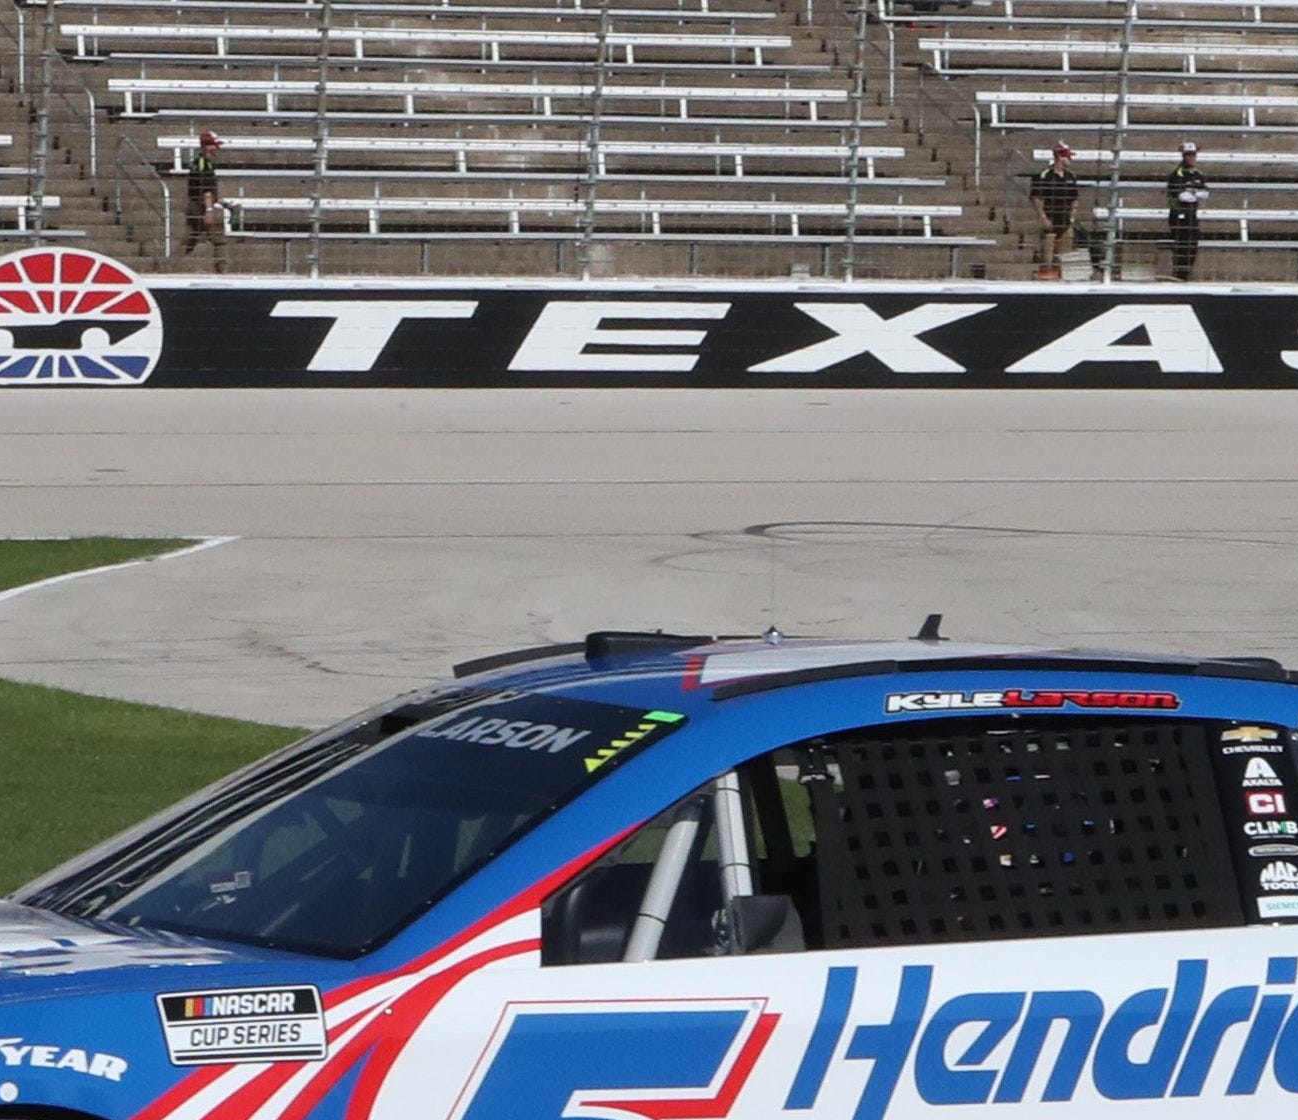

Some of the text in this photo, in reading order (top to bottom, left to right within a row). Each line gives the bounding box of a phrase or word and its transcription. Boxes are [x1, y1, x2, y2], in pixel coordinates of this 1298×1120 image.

[416, 716, 591, 753] LARSON
[1221, 745, 1283, 754] CHEVROLET
[1242, 778, 1284, 787] AXALTA
[212, 992, 295, 1016] NASCAR
[190, 1023, 302, 1047] CUP SERIES
